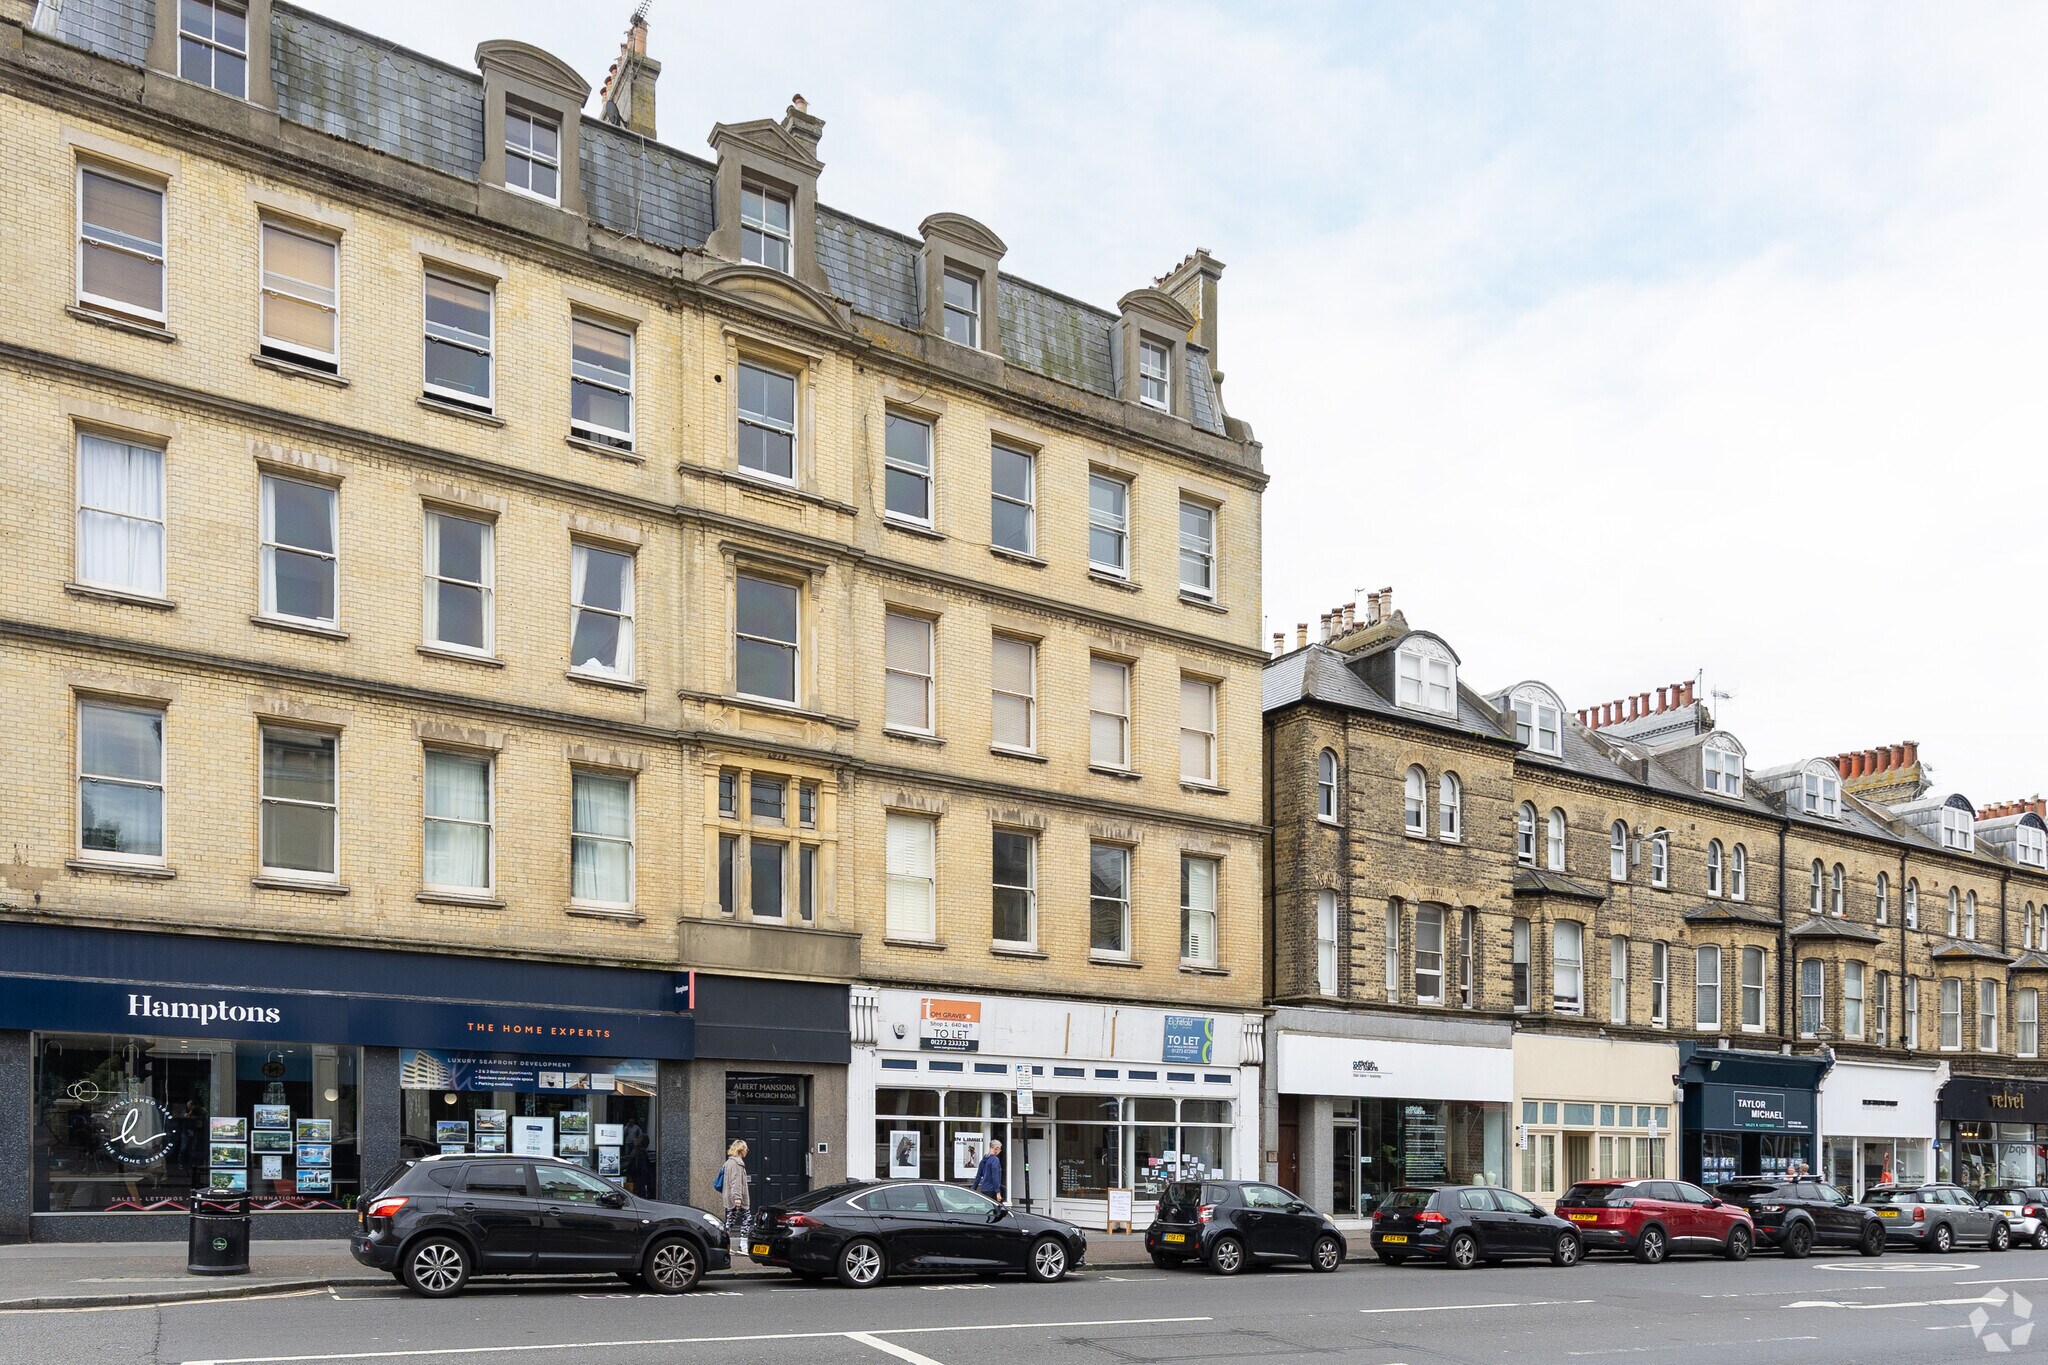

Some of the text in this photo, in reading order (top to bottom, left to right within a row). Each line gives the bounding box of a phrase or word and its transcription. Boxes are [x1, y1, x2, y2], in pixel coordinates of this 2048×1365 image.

[128, 994, 280, 1026] Hamptons
[468, 1022, 611, 1038] THE HOME EXPERTS
[934, 1029, 969, 1039] TO LET
[1168, 1035, 1200, 1046] TO LET
[1738, 1099, 1766, 1108] TAYLOR
[1991, 1091, 2024, 1108] velvet
[104, 1098, 155, 1118] ESTABLISHED
[1752, 1110, 1783, 1119] MICHAEL
[104, 1142, 173, 1164] THE HOME EXPERTS
